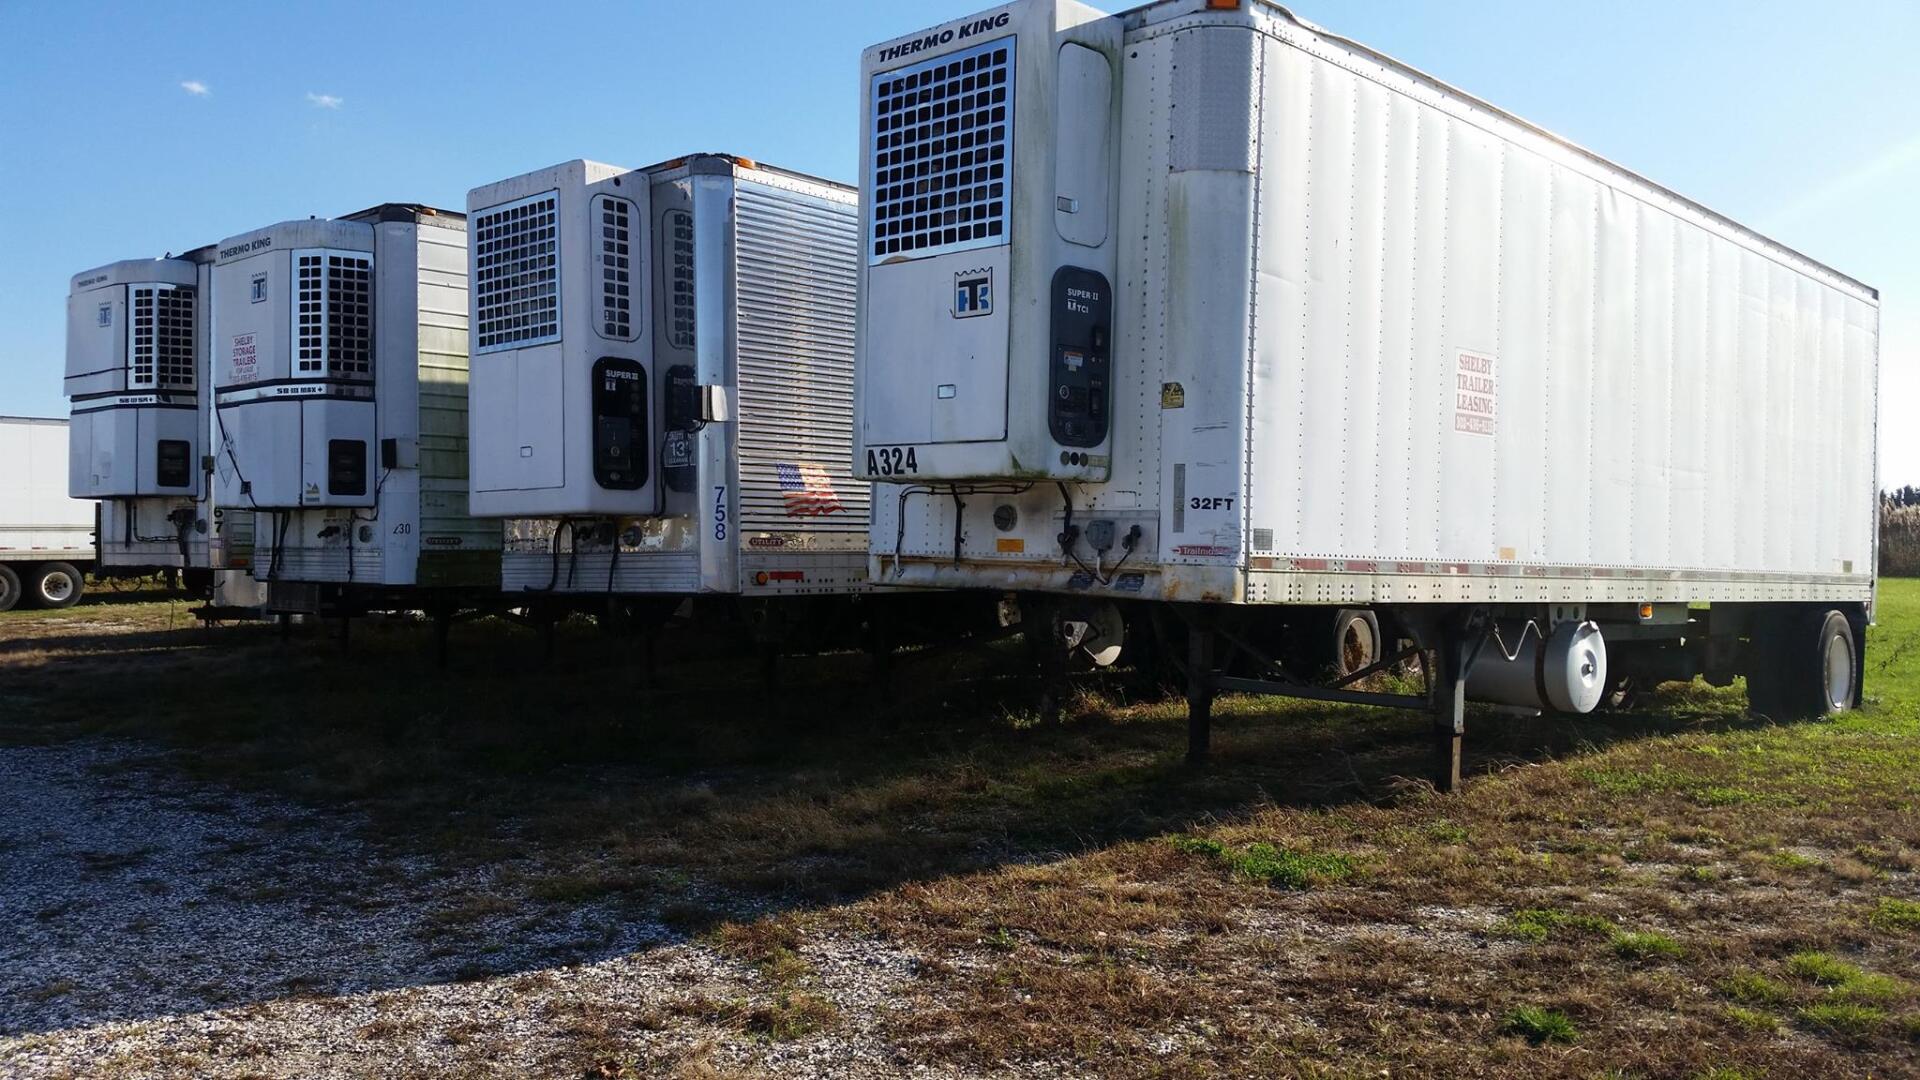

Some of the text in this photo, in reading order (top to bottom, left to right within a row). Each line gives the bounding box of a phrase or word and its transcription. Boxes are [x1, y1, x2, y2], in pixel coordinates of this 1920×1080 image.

[879, 12, 1010, 62] THERMO KING
[220, 237, 271, 259] THERMO KING
[1067, 287, 1091, 299] SUPER
[234, 336, 253, 347] SHELBY
[233, 345, 256, 358] STORAGE
[233, 355, 257, 367] TRAILERS
[1459, 353, 1494, 375] SHELBY
[605, 369, 631, 380] SUPER
[1457, 373, 1495, 395] TRAILER
[1456, 393, 1494, 415] LEASING
[867, 447, 918, 476] A324
[1190, 497, 1234, 511] 32FT
[751, 538, 782, 546] UTILITY
